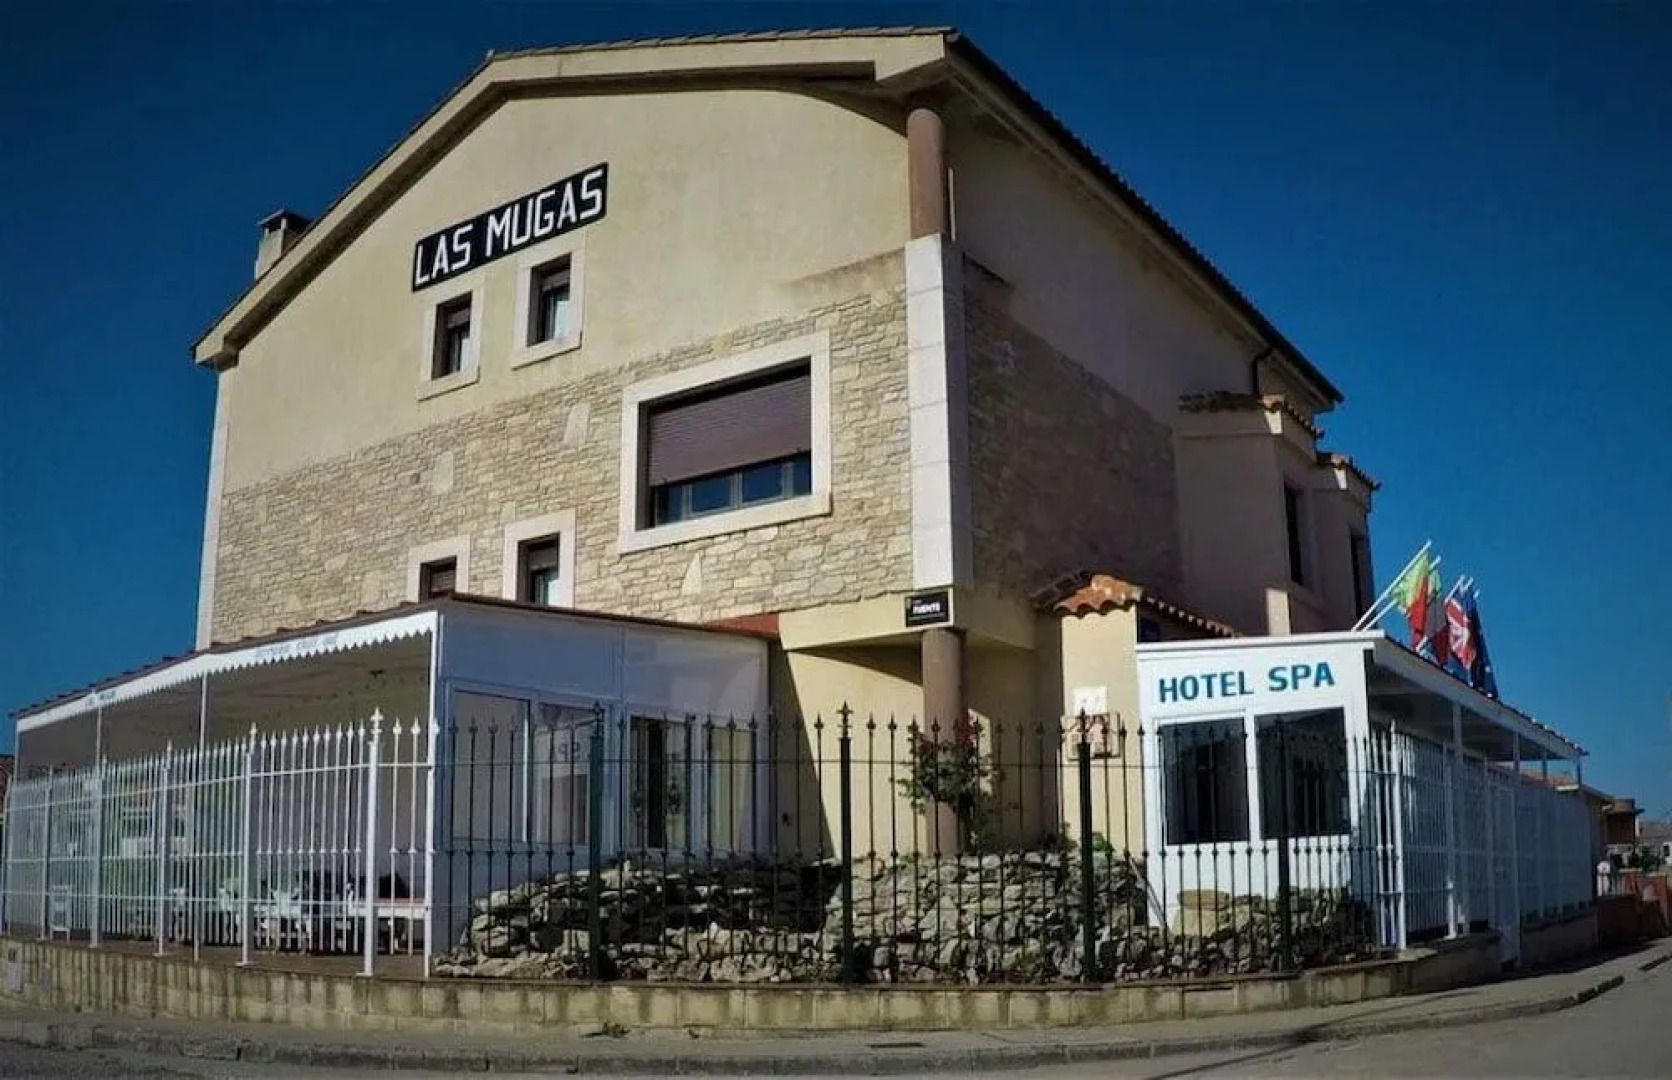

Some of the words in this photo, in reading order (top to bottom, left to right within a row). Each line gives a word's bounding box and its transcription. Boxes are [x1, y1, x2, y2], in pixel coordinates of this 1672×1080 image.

[416, 223, 474, 286] LAS
[484, 170, 604, 257] MUGAS
[1159, 671, 1254, 703] HOTEL
[1268, 661, 1335, 692] SPA
